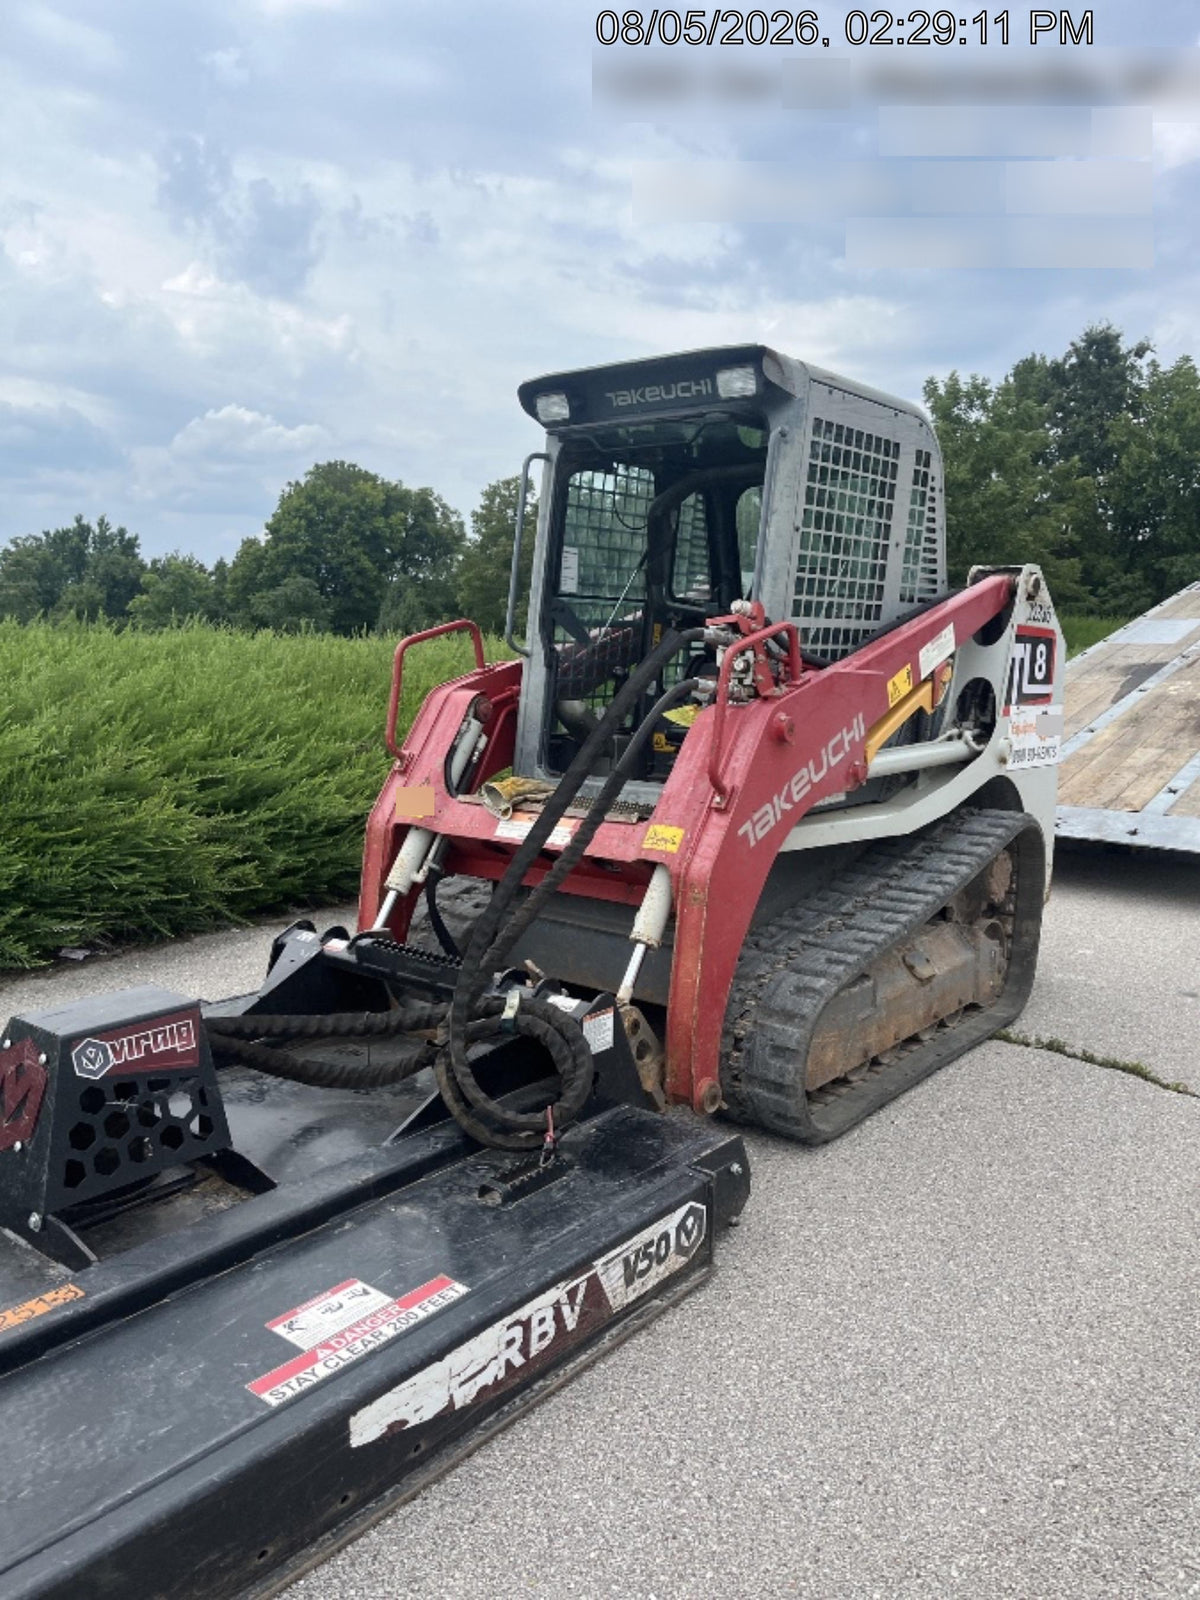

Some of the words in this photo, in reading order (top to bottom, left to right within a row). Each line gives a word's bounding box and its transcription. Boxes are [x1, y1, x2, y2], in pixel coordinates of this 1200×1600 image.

[622, 1231, 671, 1287] V50
[269, 1367, 322, 1401] STAY
[322, 1330, 385, 1371] CLEAR
[386, 1310, 419, 1335] 200
[420, 1284, 464, 1313] FEET
[330, 1303, 404, 1350] DANGER
